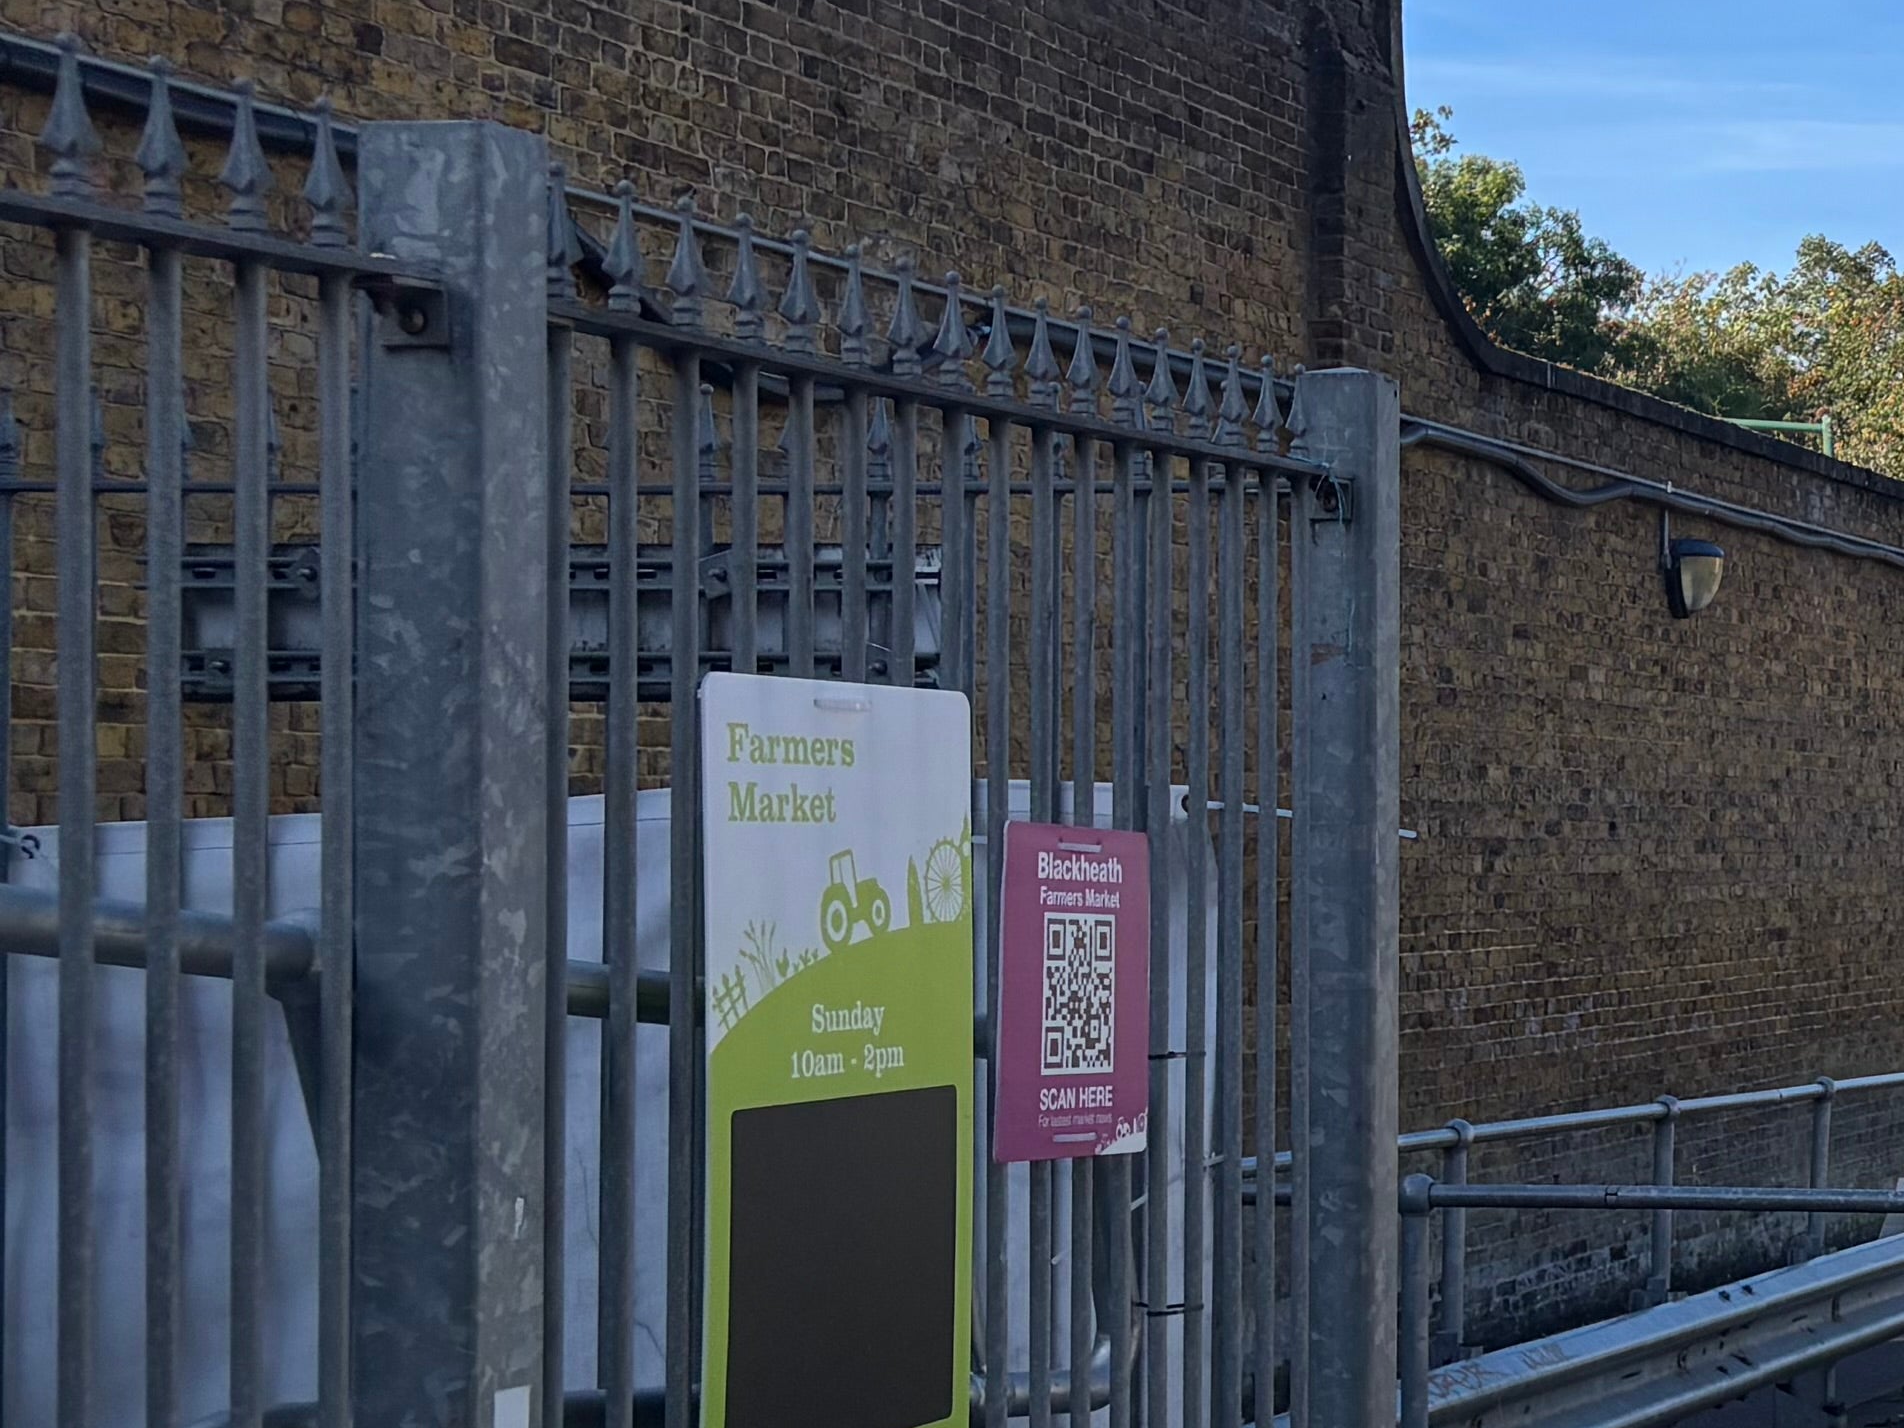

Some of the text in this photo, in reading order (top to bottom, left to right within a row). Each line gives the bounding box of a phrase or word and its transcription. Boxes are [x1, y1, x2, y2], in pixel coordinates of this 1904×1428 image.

[727, 722, 855, 767] Farmers
[727, 781, 837, 823] Market
[1037, 851, 1123, 884] Blackheath
[1039, 885, 1120, 909] Farmers Market
[811, 1000, 886, 1036] Sunday
[790, 1050, 846, 1079] 10am
[863, 1043, 906, 1078] 2pm
[1039, 1085, 1113, 1111] SCAN HERE
